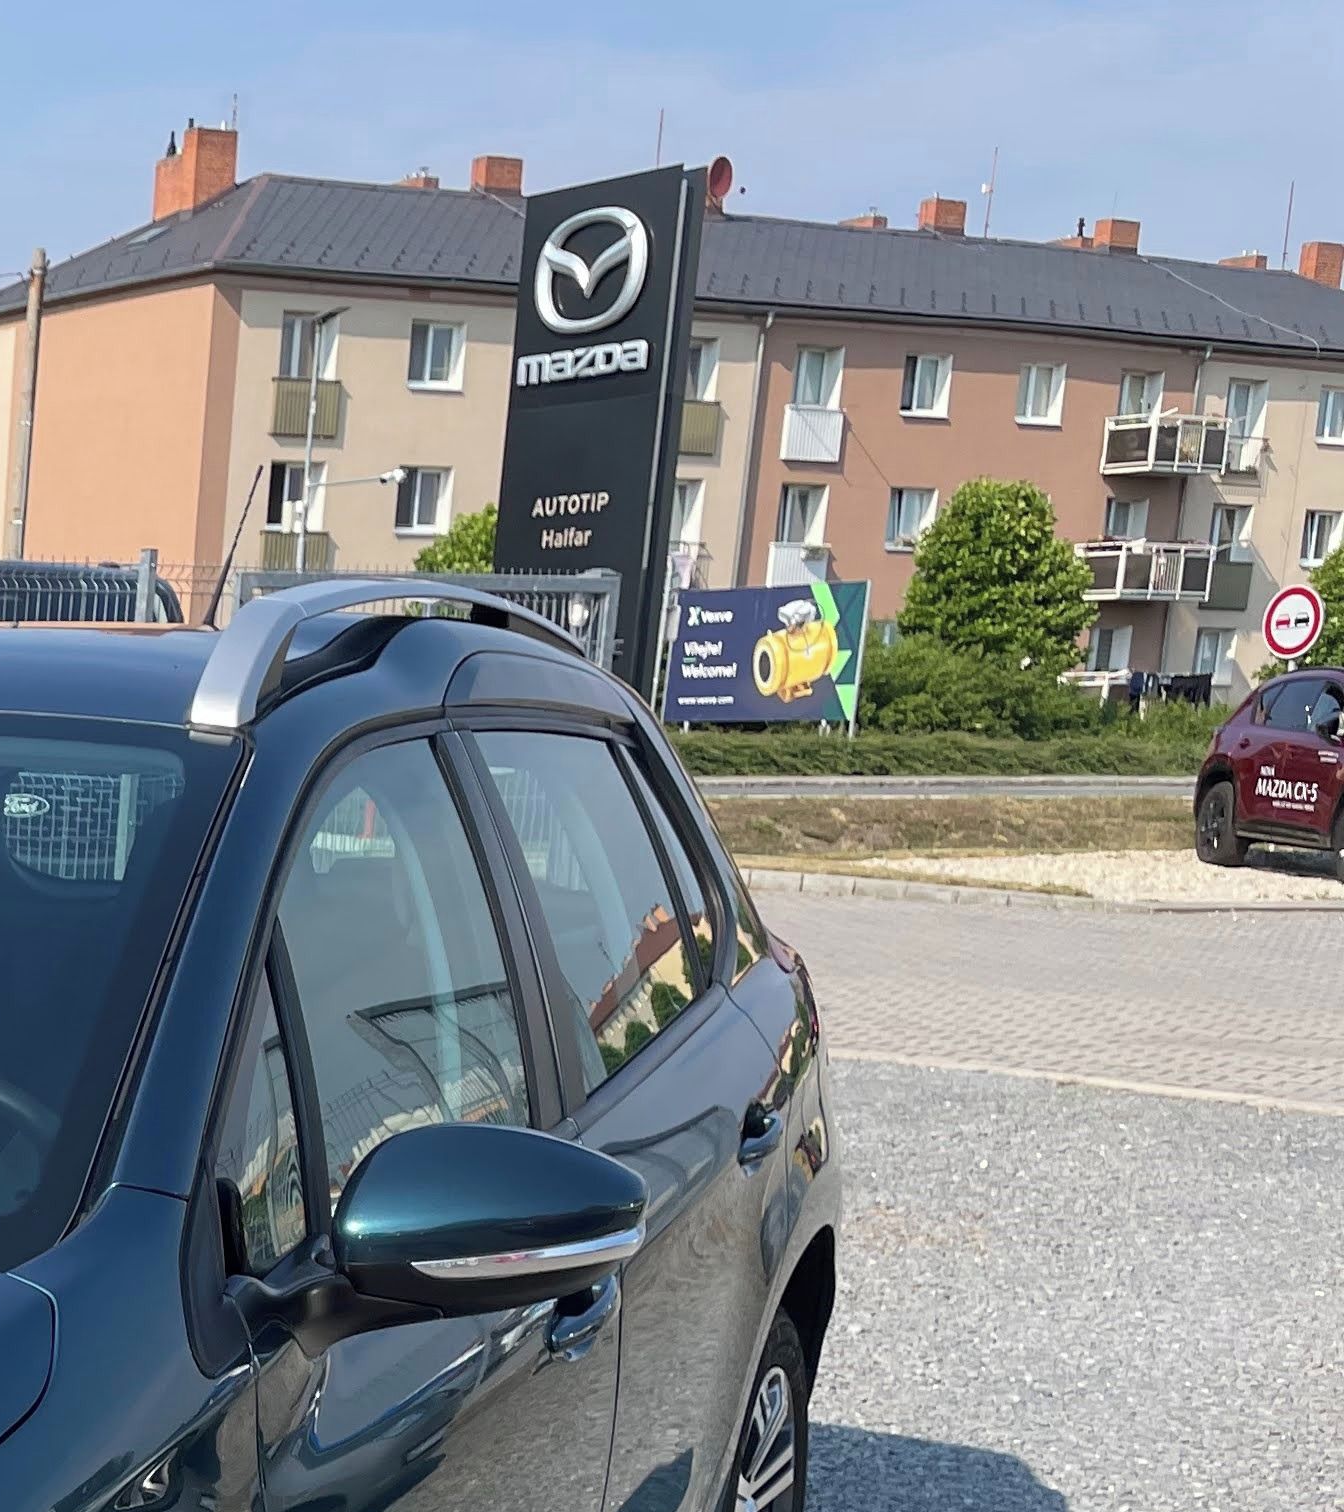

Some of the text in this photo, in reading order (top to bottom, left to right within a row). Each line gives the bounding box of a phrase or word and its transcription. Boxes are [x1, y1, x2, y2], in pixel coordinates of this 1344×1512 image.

[531, 491, 610, 518] AUTOTIP
[541, 527, 593, 550] Halfar
[1255, 778, 1318, 803] MAZDA CX-5
